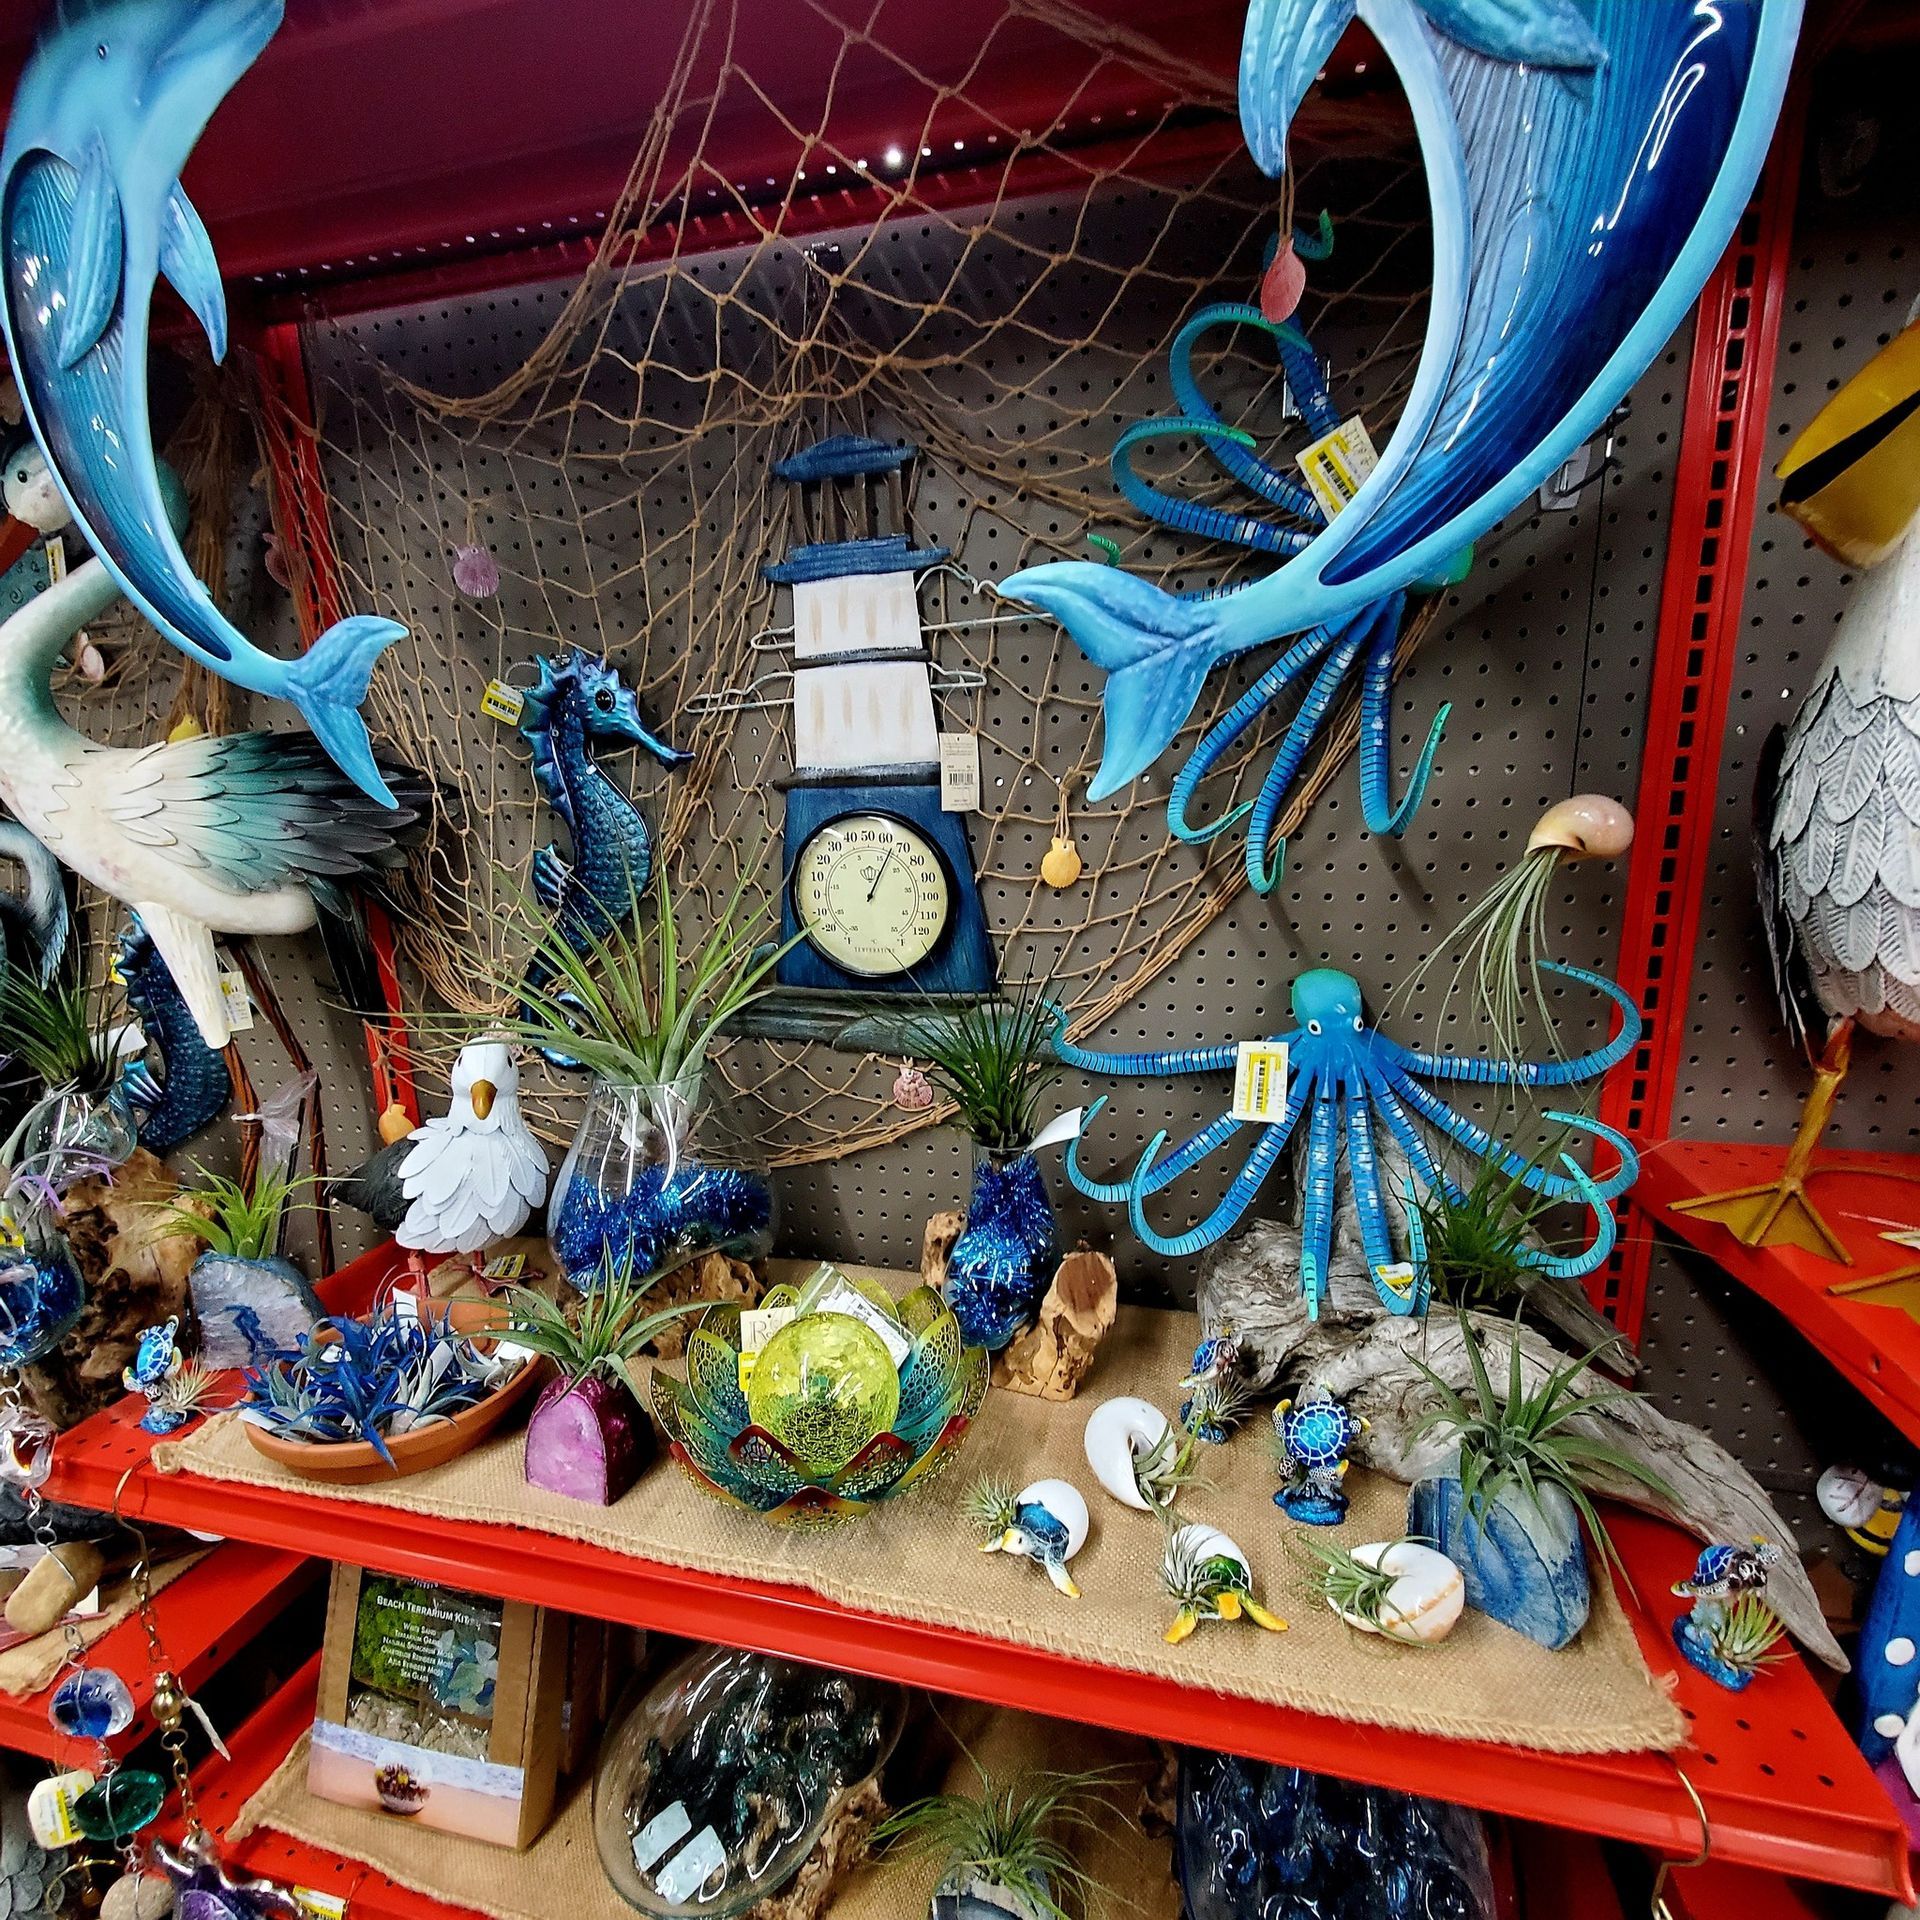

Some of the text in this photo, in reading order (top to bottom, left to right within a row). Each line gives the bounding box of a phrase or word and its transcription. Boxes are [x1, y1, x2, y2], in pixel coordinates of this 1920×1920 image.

[844, 832, 857, 843] 40
[861, 831, 875, 841] 50
[879, 833, 893, 843] 60
[828, 842, 842, 852] 30
[896, 843, 910, 853] 70
[817, 855, 830, 865] 20
[910, 856, 924, 866] 80
[812, 872, 824, 881] 10
[922, 872, 935, 883] 90
[814, 890, 821, 899] 0
[922, 892, 939, 900] 100
[813, 908, 827, 916] -10
[921, 912, 937, 920] 110
[822, 923, 836, 932] -20
[913, 927, 929, 936] 120
